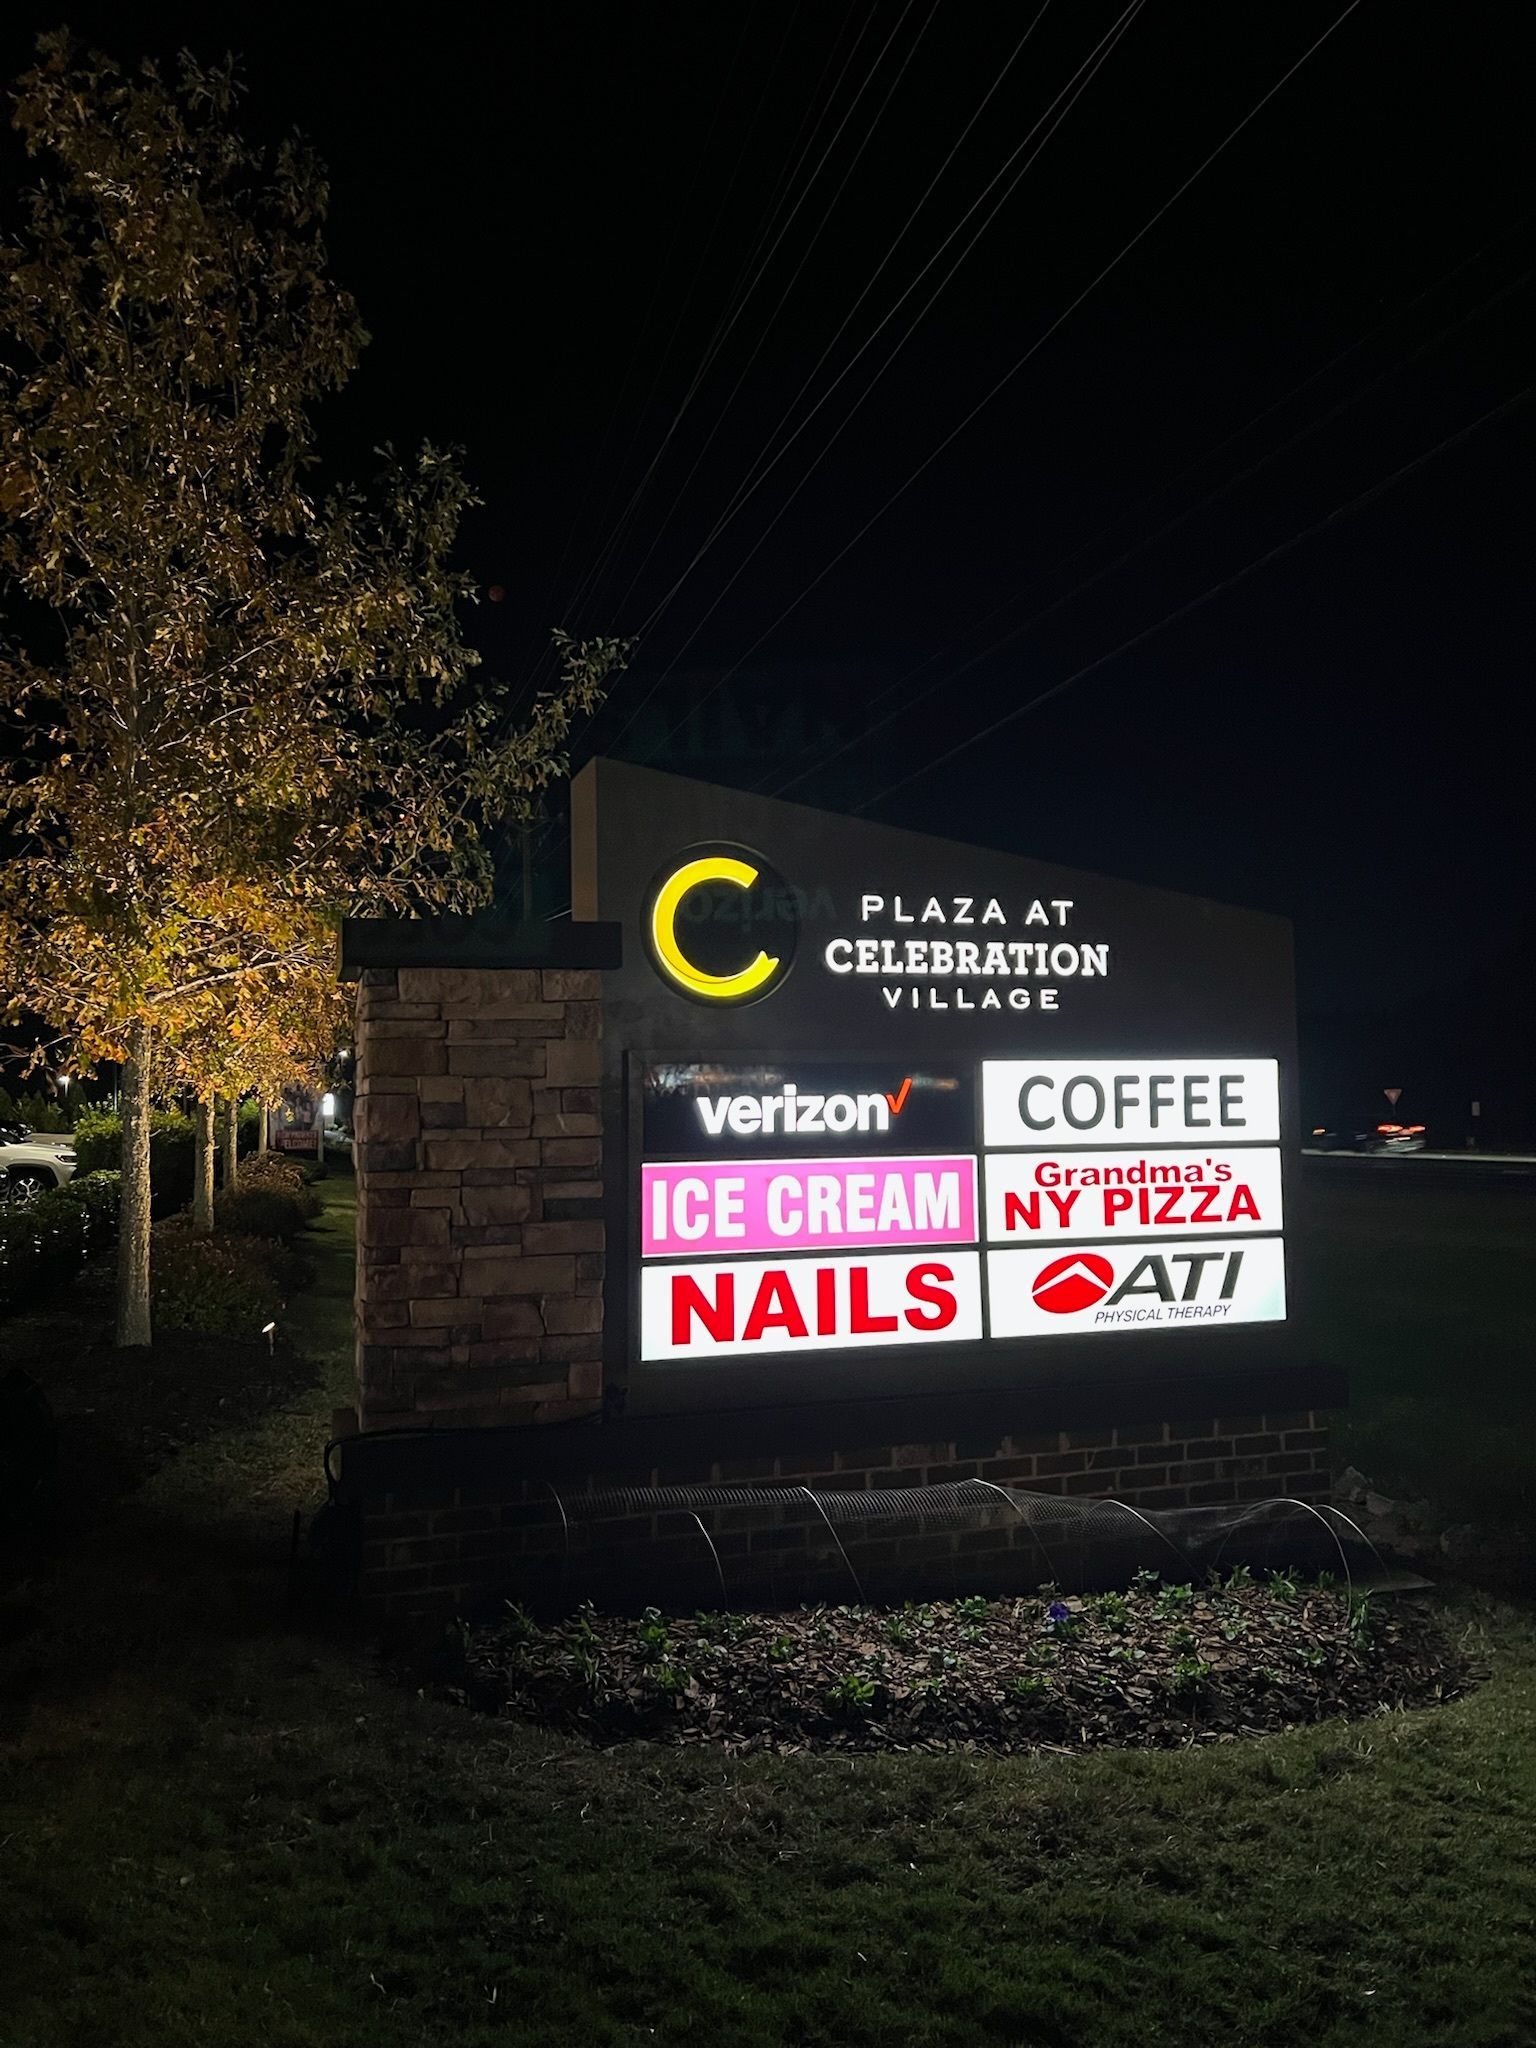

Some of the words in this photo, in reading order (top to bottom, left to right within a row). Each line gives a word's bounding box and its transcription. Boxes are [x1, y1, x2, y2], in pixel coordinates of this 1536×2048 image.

[862, 895, 1006, 924] PLAZA
[1026, 900, 1073, 926] AT
[826, 939, 1109, 976] CELEBRATION
[883, 987, 1058, 1009] VILLAGE
[696, 1083, 889, 1135] verizon
[1019, 1075, 1246, 1131] COFFEE
[1034, 1158, 1233, 1187] Grandma's
[654, 1178, 744, 1239] ICE
[768, 1173, 959, 1235] CREAM
[1005, 1190, 1081, 1231] NY
[1104, 1184, 1261, 1226] PIZZA
[1103, 1251, 1244, 1306] ATI
[671, 1263, 958, 1345] NAILS
[1095, 1309, 1162, 1323] PHYSICAL
[1168, 1305, 1231, 1318] THERAPY
